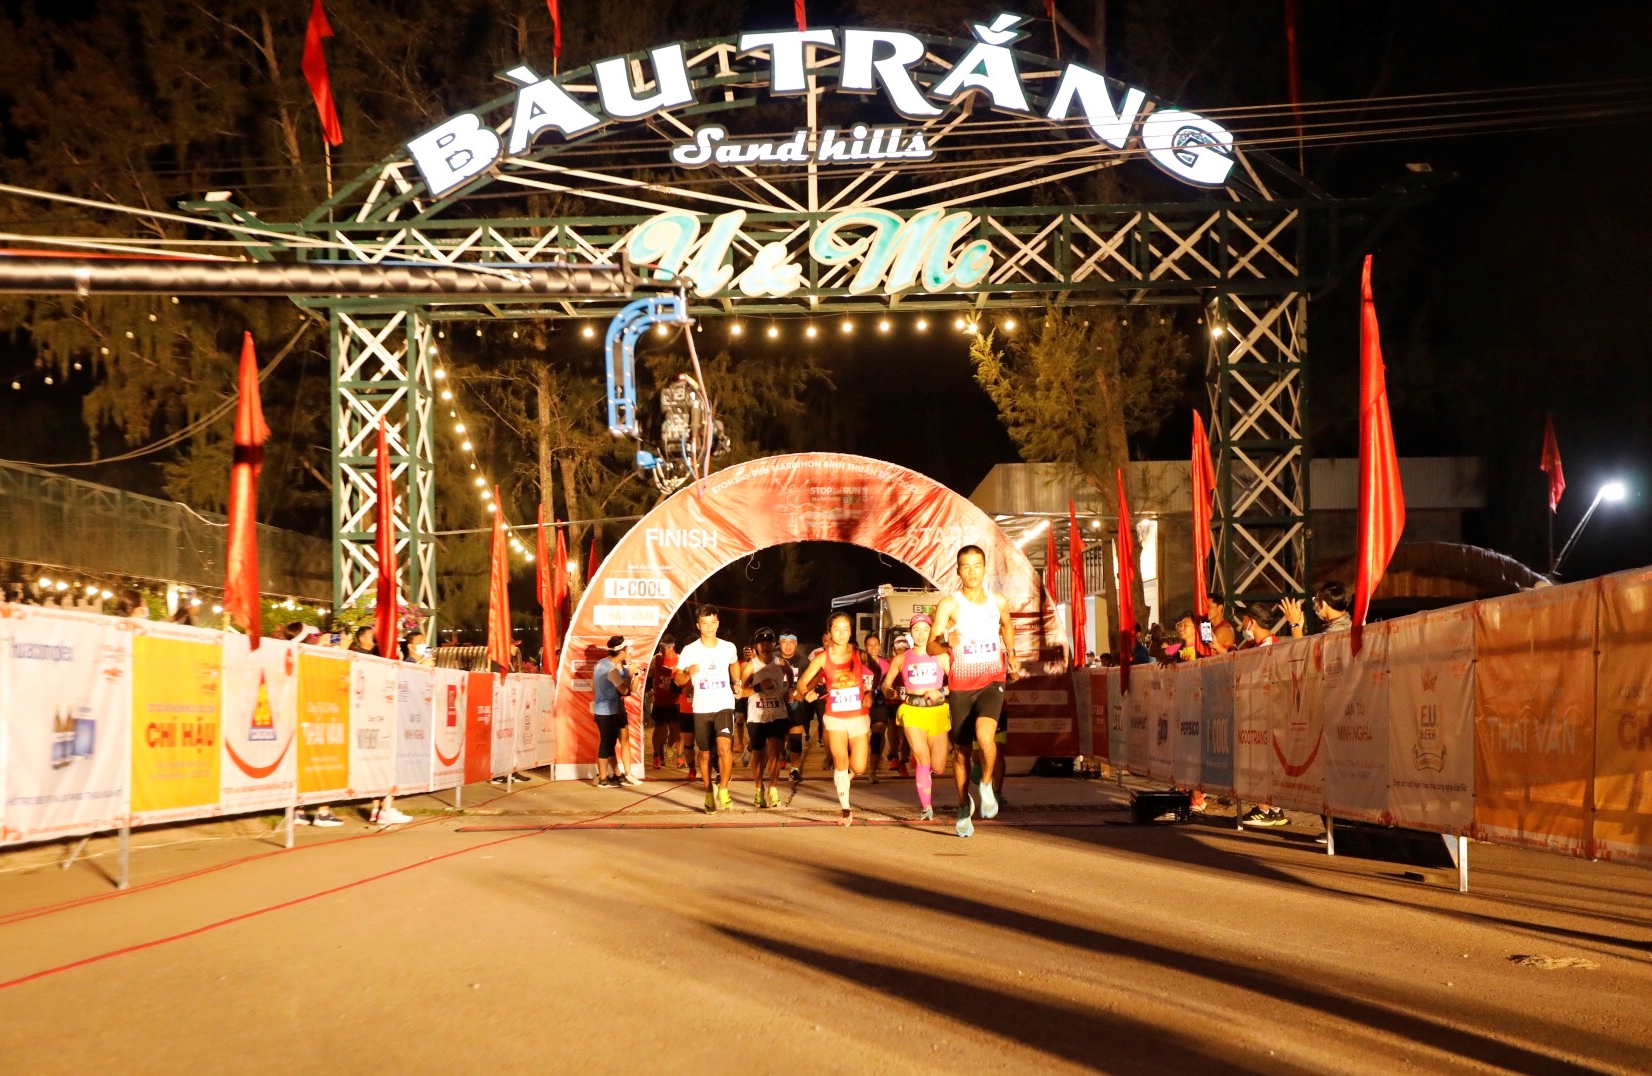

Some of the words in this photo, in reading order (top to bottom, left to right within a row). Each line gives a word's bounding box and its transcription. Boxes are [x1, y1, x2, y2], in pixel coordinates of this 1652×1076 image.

[407, 42, 697, 197] BÀU
[739, 13, 1235, 184] TRẮNG
[739, 240, 803, 298] &
[809, 206, 995, 297] Me
[711, 477, 734, 495] STOP
[751, 467, 770, 478] RUN
[771, 459, 821, 472] MARATHON
[810, 486, 833, 495] STOP
[843, 486, 861, 495] RUN
[645, 528, 718, 549] FINISH
[145, 716, 177, 748] CHÍ
[1421, 704, 1437, 728] EU
